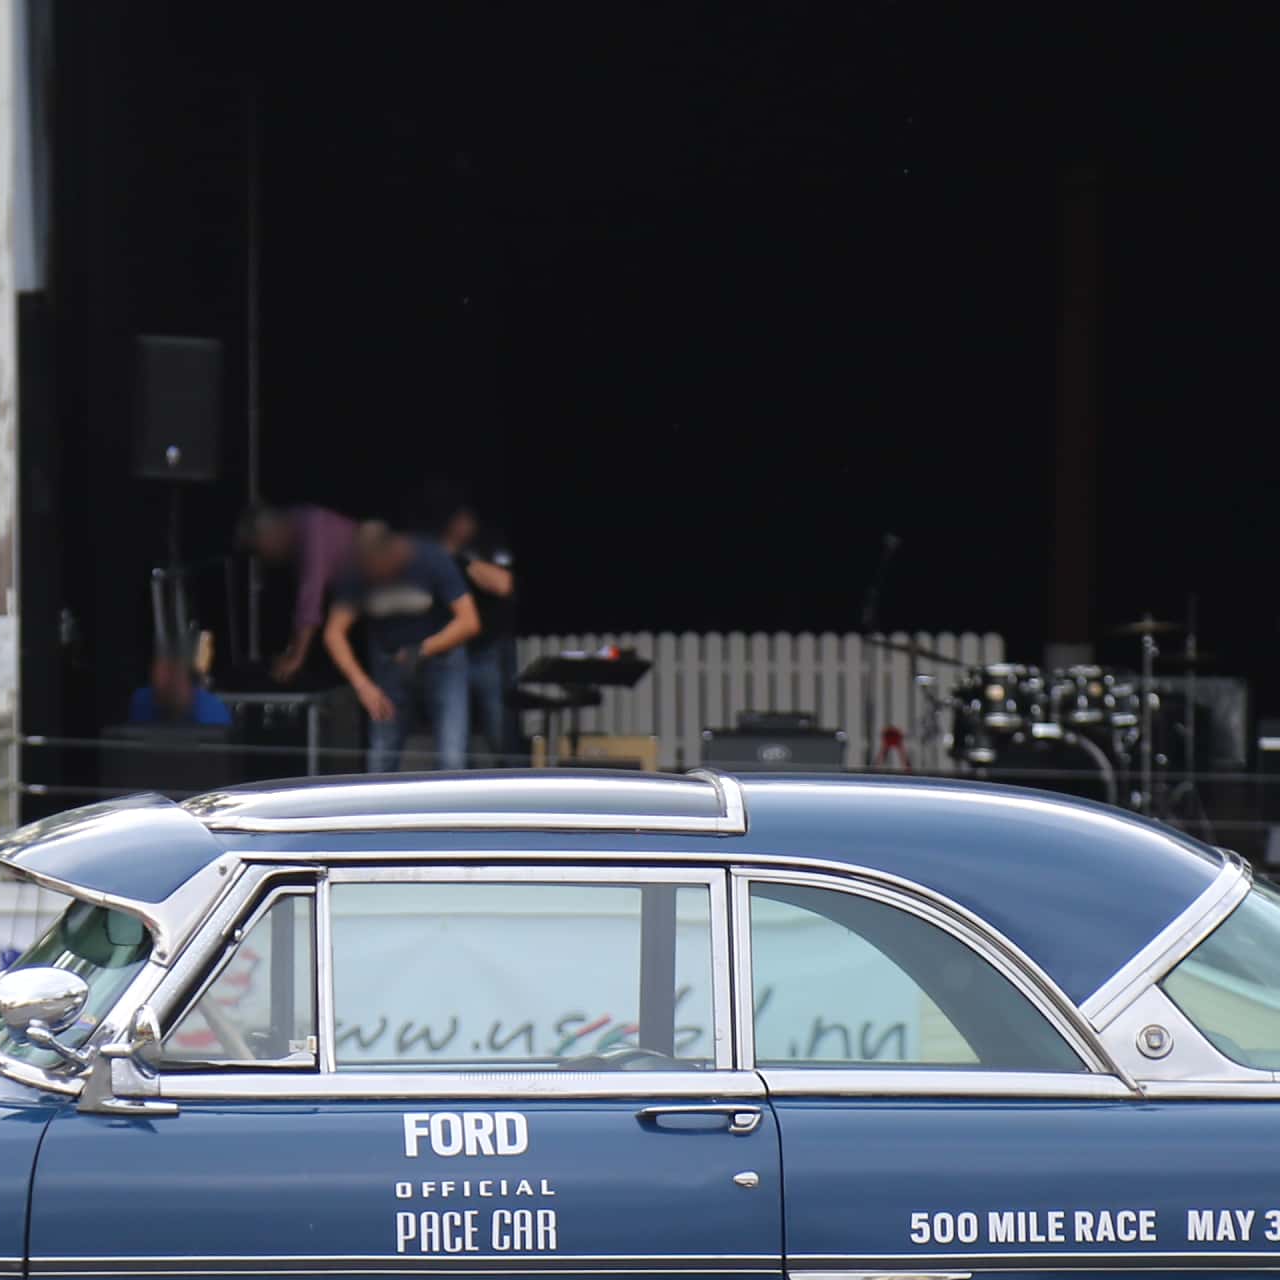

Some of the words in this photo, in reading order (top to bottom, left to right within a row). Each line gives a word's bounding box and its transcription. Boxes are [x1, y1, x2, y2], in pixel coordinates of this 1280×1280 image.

[403, 1111, 529, 1157] FORD
[395, 1179, 556, 1198] OFFICIAL
[396, 1210, 480, 1253] PACE
[491, 1208, 557, 1251] CAR
[910, 1211, 979, 1243] 500
[987, 1211, 1066, 1243] MILE
[1074, 1210, 1157, 1242] RACE
[1187, 1210, 1255, 1242] MAY
